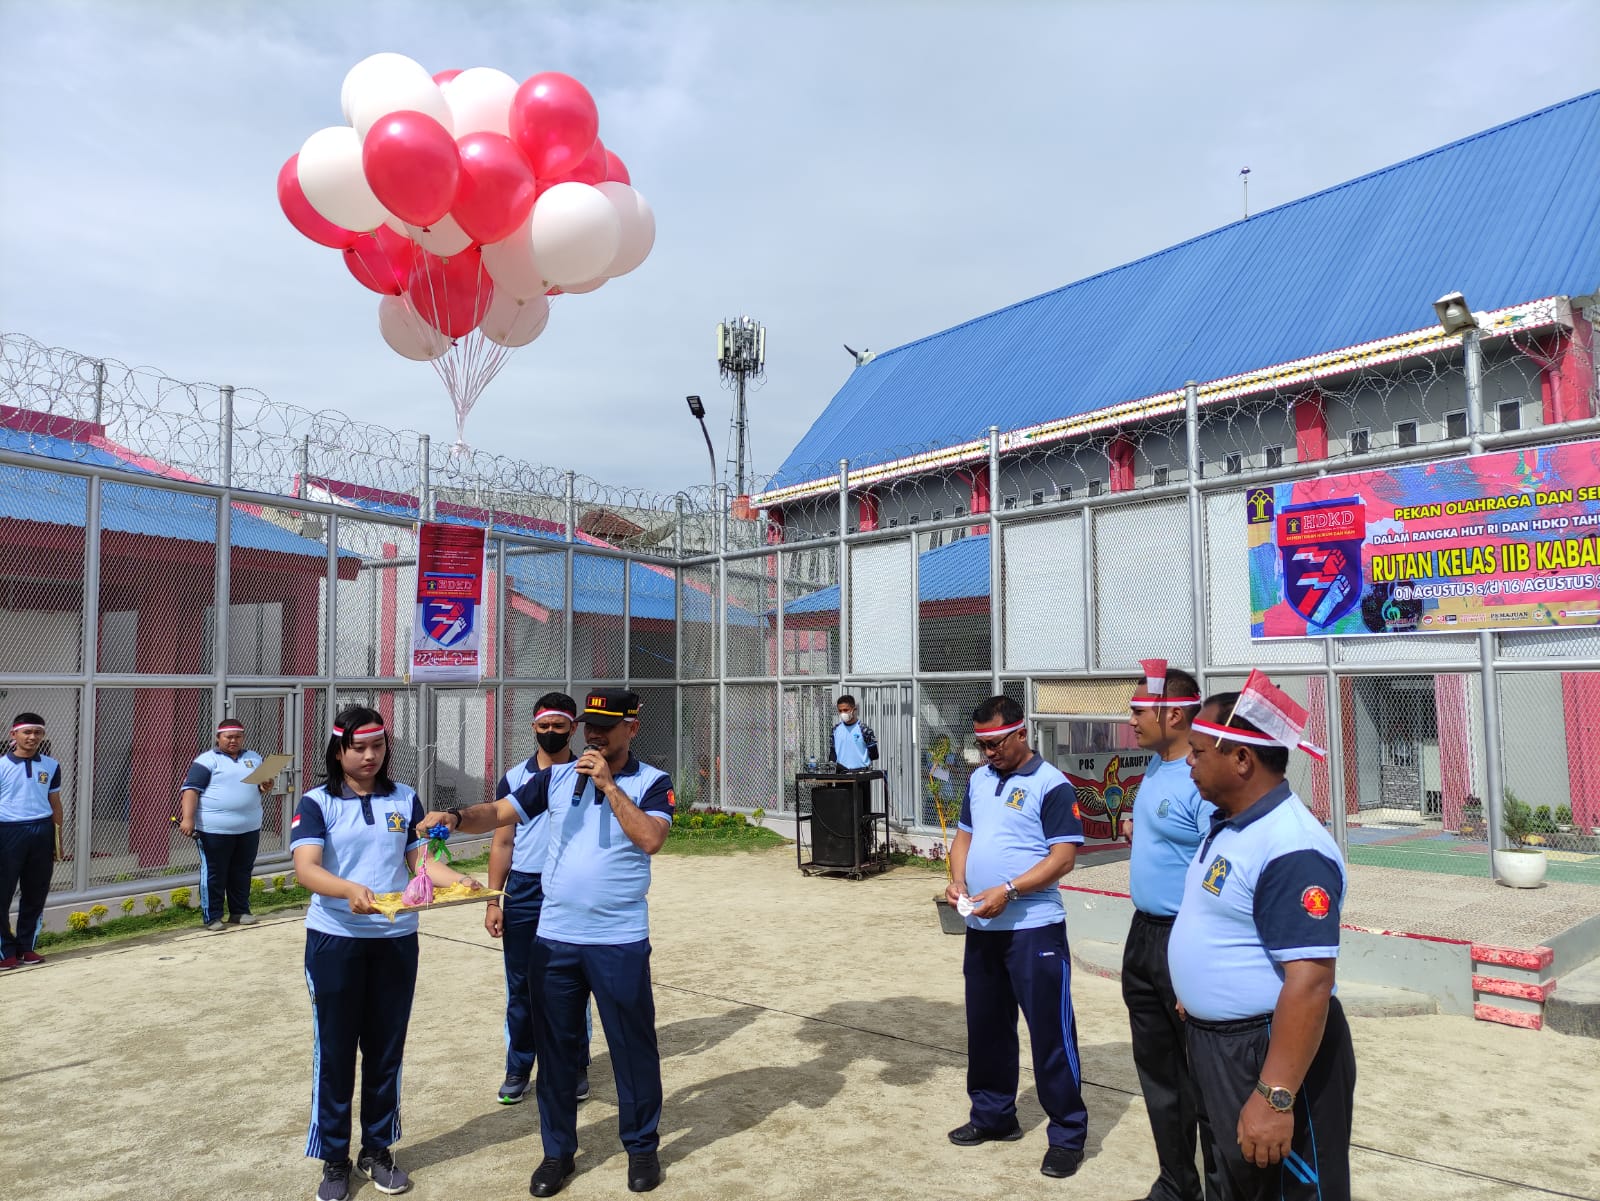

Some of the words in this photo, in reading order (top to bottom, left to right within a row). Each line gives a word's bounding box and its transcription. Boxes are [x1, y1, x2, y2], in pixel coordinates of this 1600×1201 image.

[1394, 505, 1441, 521] PEKAN
[1445, 494, 1531, 516] OLAHRAGA
[1535, 489, 1573, 507] DAN
[1303, 510, 1354, 529] HDKD
[1373, 533, 1410, 545] DALAM
[1412, 528, 1459, 542] RANGKA
[1461, 525, 1484, 537] HUT
[1487, 524, 1499, 535] RI
[1502, 521, 1528, 533] DAN
[1532, 517, 1569, 530] HDKD
[1371, 550, 1432, 582] RUTAN
[1437, 545, 1496, 577] KELAS
[1501, 543, 1530, 573] IIB
[1394, 588, 1411, 601] 01
[1414, 582, 1474, 599] AGUSTUS
[1477, 580, 1499, 595] s/d
[1503, 579, 1521, 594] 16
[1523, 574, 1595, 593] AGUSTUS
[1078, 758, 1095, 770] POS
